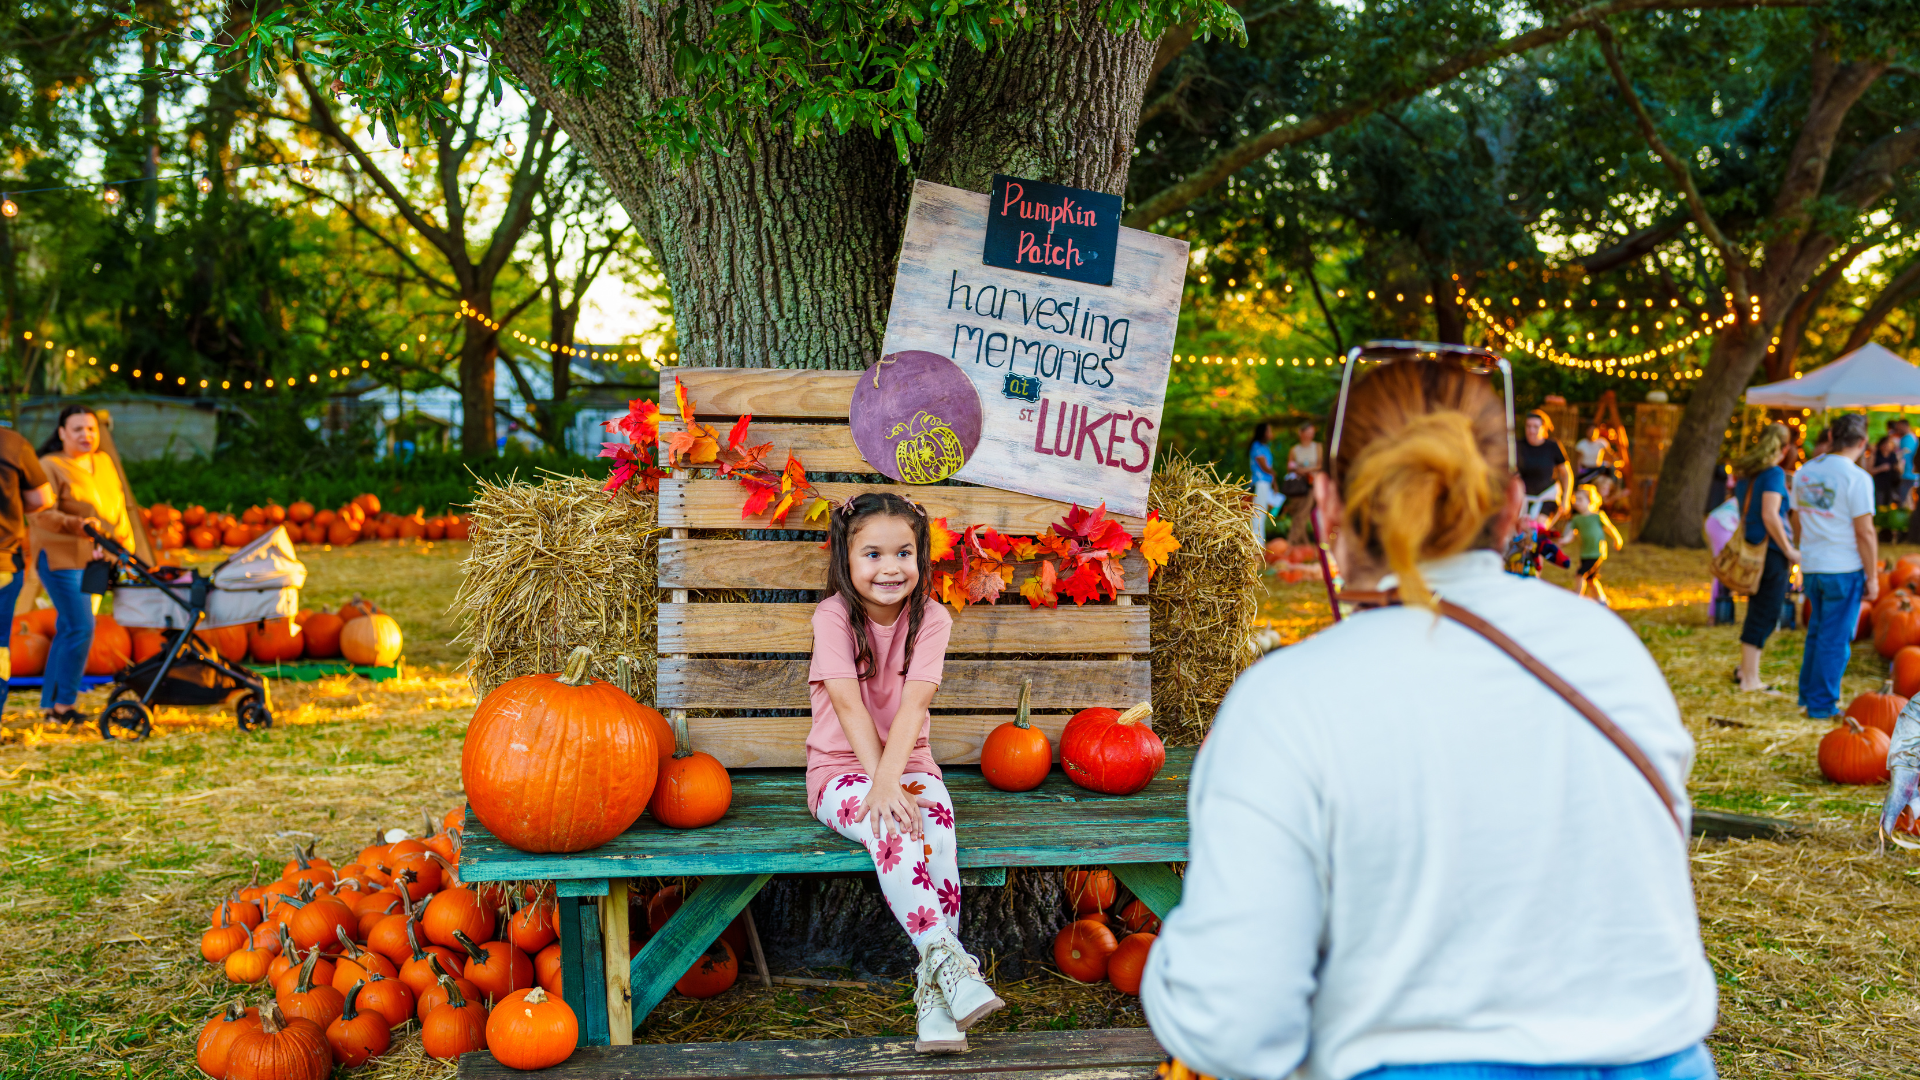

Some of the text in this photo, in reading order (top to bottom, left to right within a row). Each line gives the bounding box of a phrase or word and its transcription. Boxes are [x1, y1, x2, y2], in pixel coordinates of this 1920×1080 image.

[1001, 182, 1097, 231] Pumpkin
[1015, 230, 1083, 269] Patch
[948, 270, 1130, 360] harvesting
[952, 323, 1114, 388] memories
[1010, 379, 1029, 396] at
[1034, 398, 1154, 473] LUKE'S
